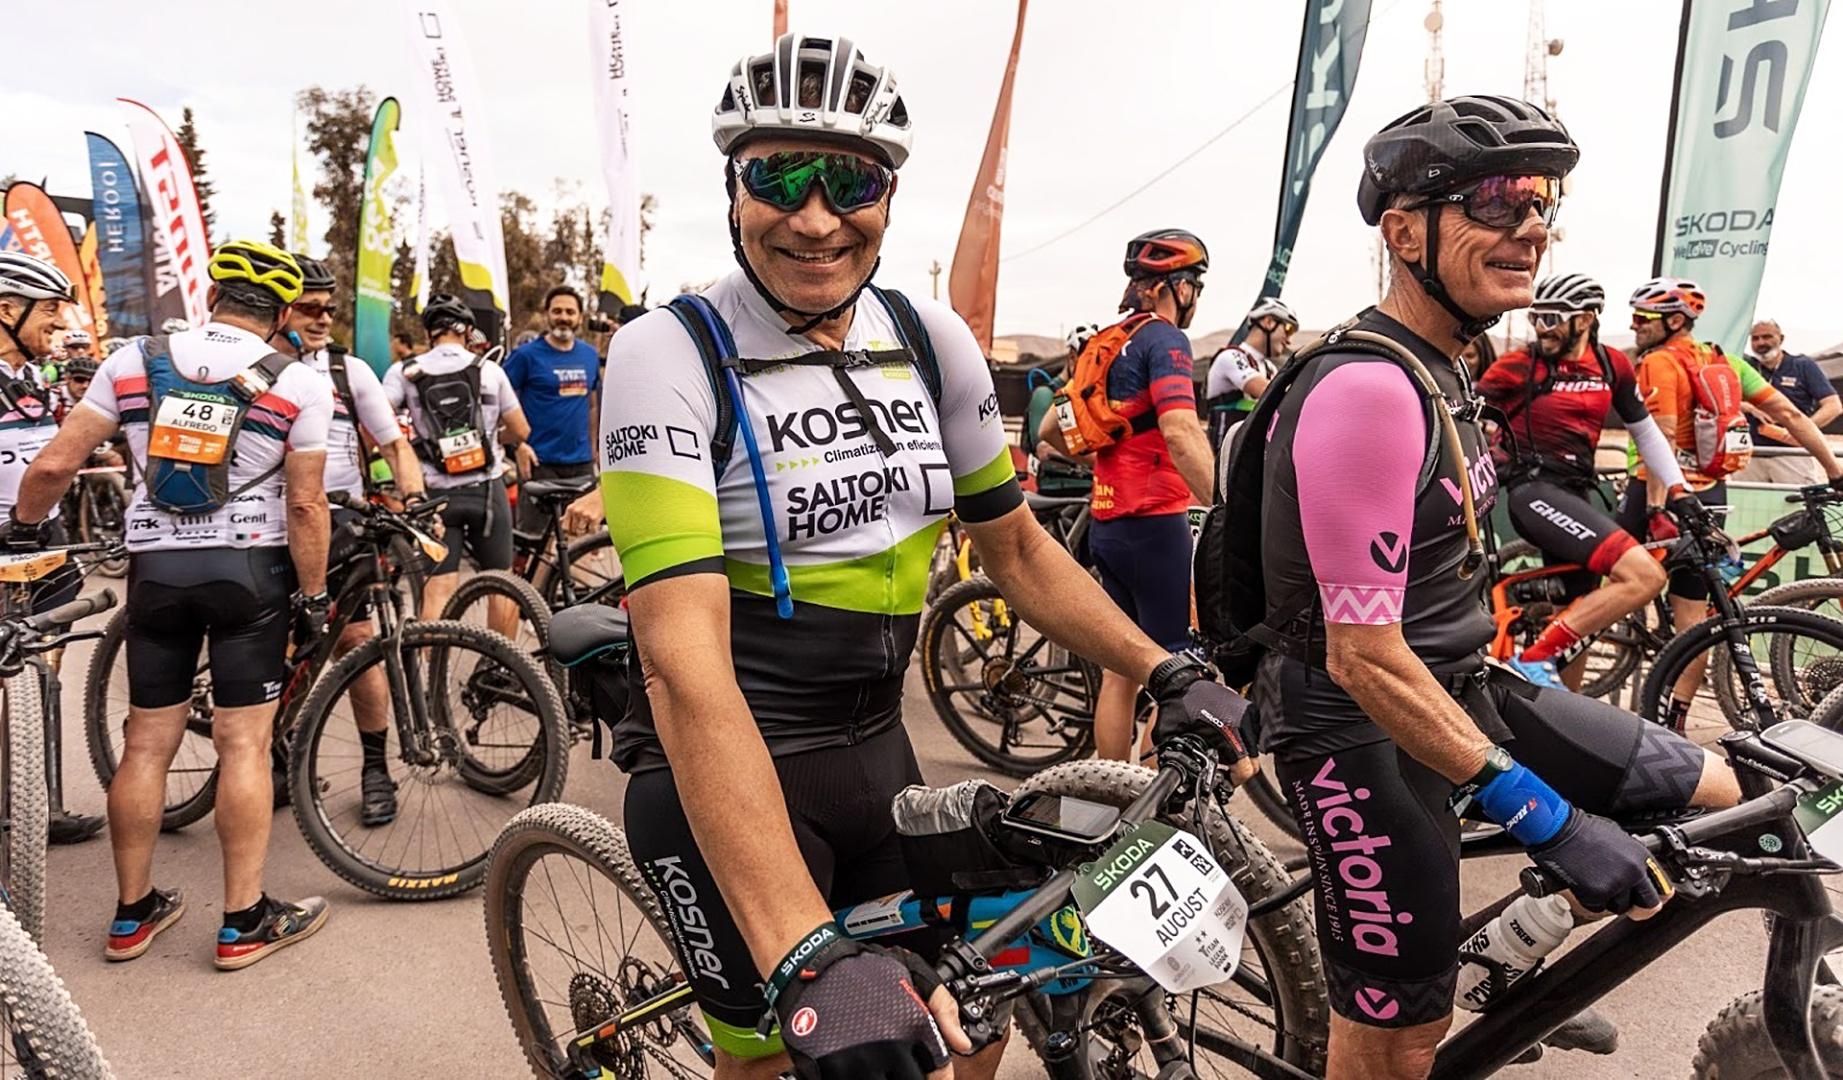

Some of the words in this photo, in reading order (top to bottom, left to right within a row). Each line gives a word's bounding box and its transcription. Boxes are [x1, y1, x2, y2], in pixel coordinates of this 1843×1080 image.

[171, 419, 217, 432] ALFREDO
[182, 403, 213, 421] 48
[978, 393, 999, 421] KO
[606, 425, 658, 450] SALTOKI
[607, 440, 647, 466] HOME
[786, 466, 911, 515] SALTOKI
[788, 496, 885, 542] HOME
[1529, 499, 1597, 541] GHOST
[1292, 780, 1313, 818] MADE
[1816, 786, 1843, 814] SK
[1093, 838, 1155, 891] SKODA
[1310, 757, 1413, 956] victoria
[1130, 862, 1180, 920] 27
[1155, 887, 1209, 947] AUGUST
[781, 928, 835, 976] SKODA
